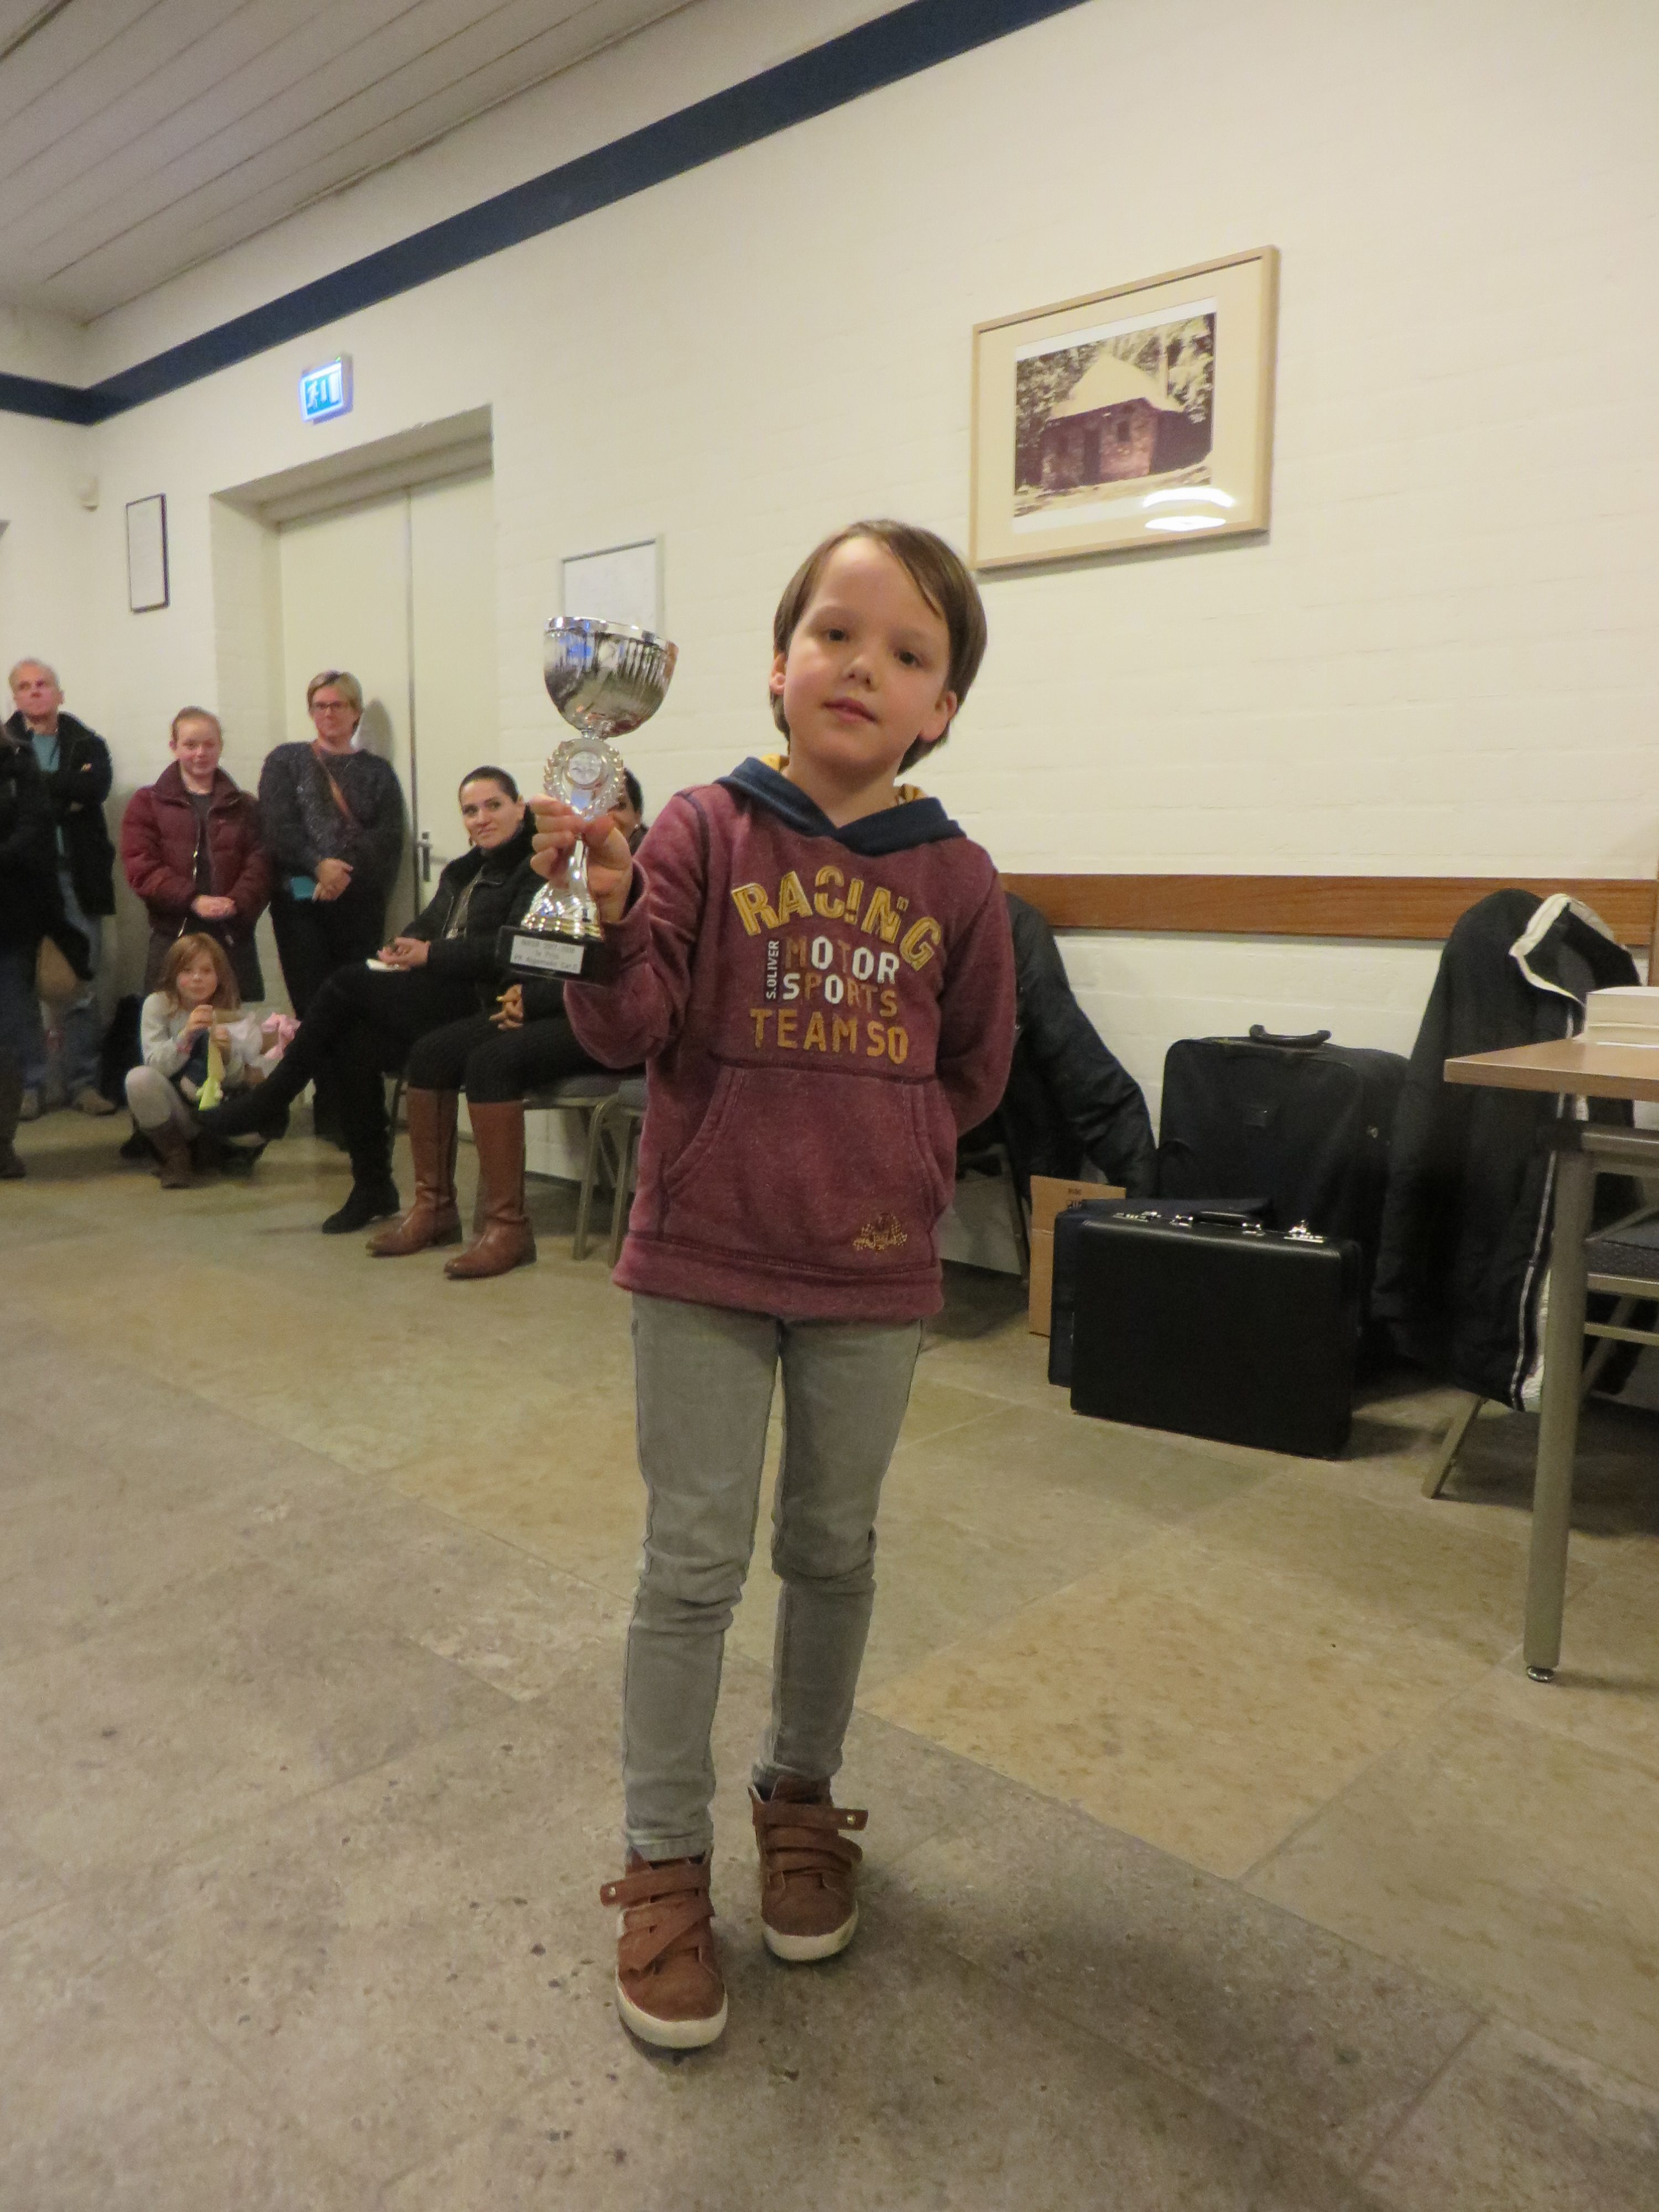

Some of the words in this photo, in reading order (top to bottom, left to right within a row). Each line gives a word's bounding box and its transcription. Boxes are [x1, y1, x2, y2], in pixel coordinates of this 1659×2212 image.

[731, 865, 942, 971] RACING
[766, 940, 780, 1000] S.OLIVER
[785, 936, 899, 985] MOTOR
[782, 973, 898, 1018] SPORTS
